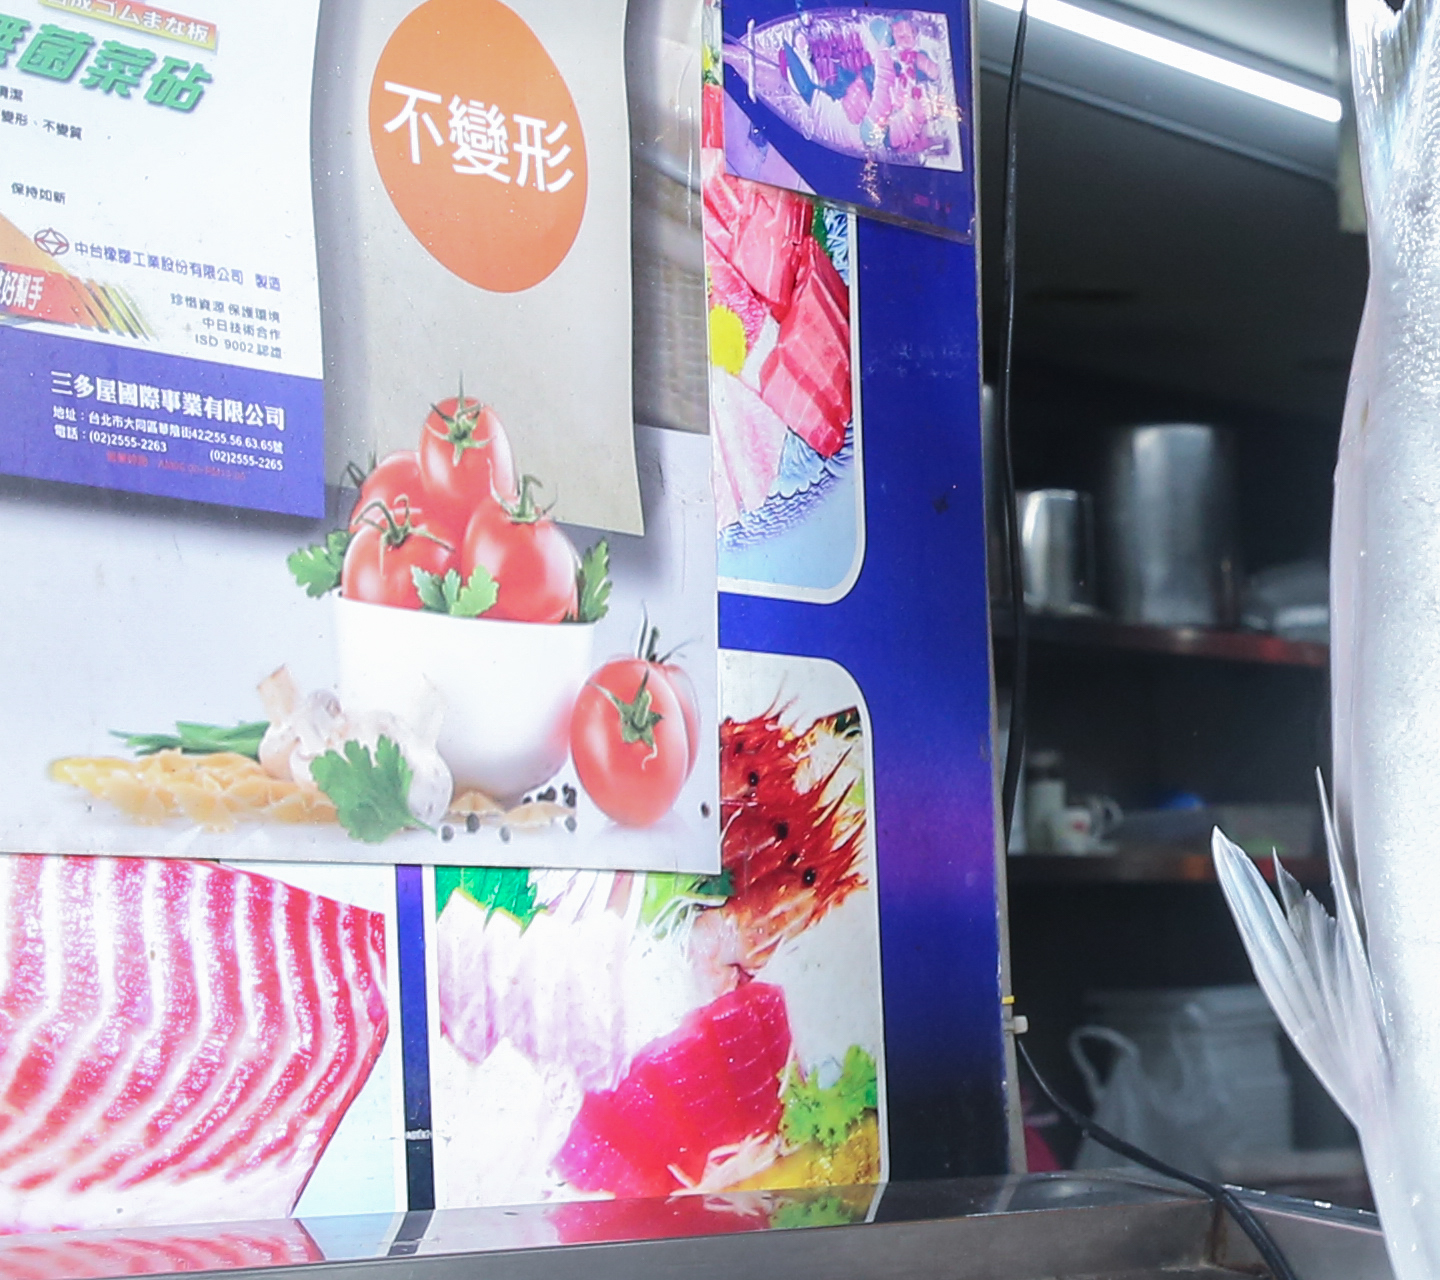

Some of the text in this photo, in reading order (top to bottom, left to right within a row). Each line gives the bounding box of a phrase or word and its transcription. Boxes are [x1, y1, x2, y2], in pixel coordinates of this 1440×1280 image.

[383, 80, 575, 194] 不變形
[194, 333, 219, 348] ISO
[50, 370, 286, 432] 三多屋國際事業有限公司
[210, 448, 284, 471] (02)2555-2265
